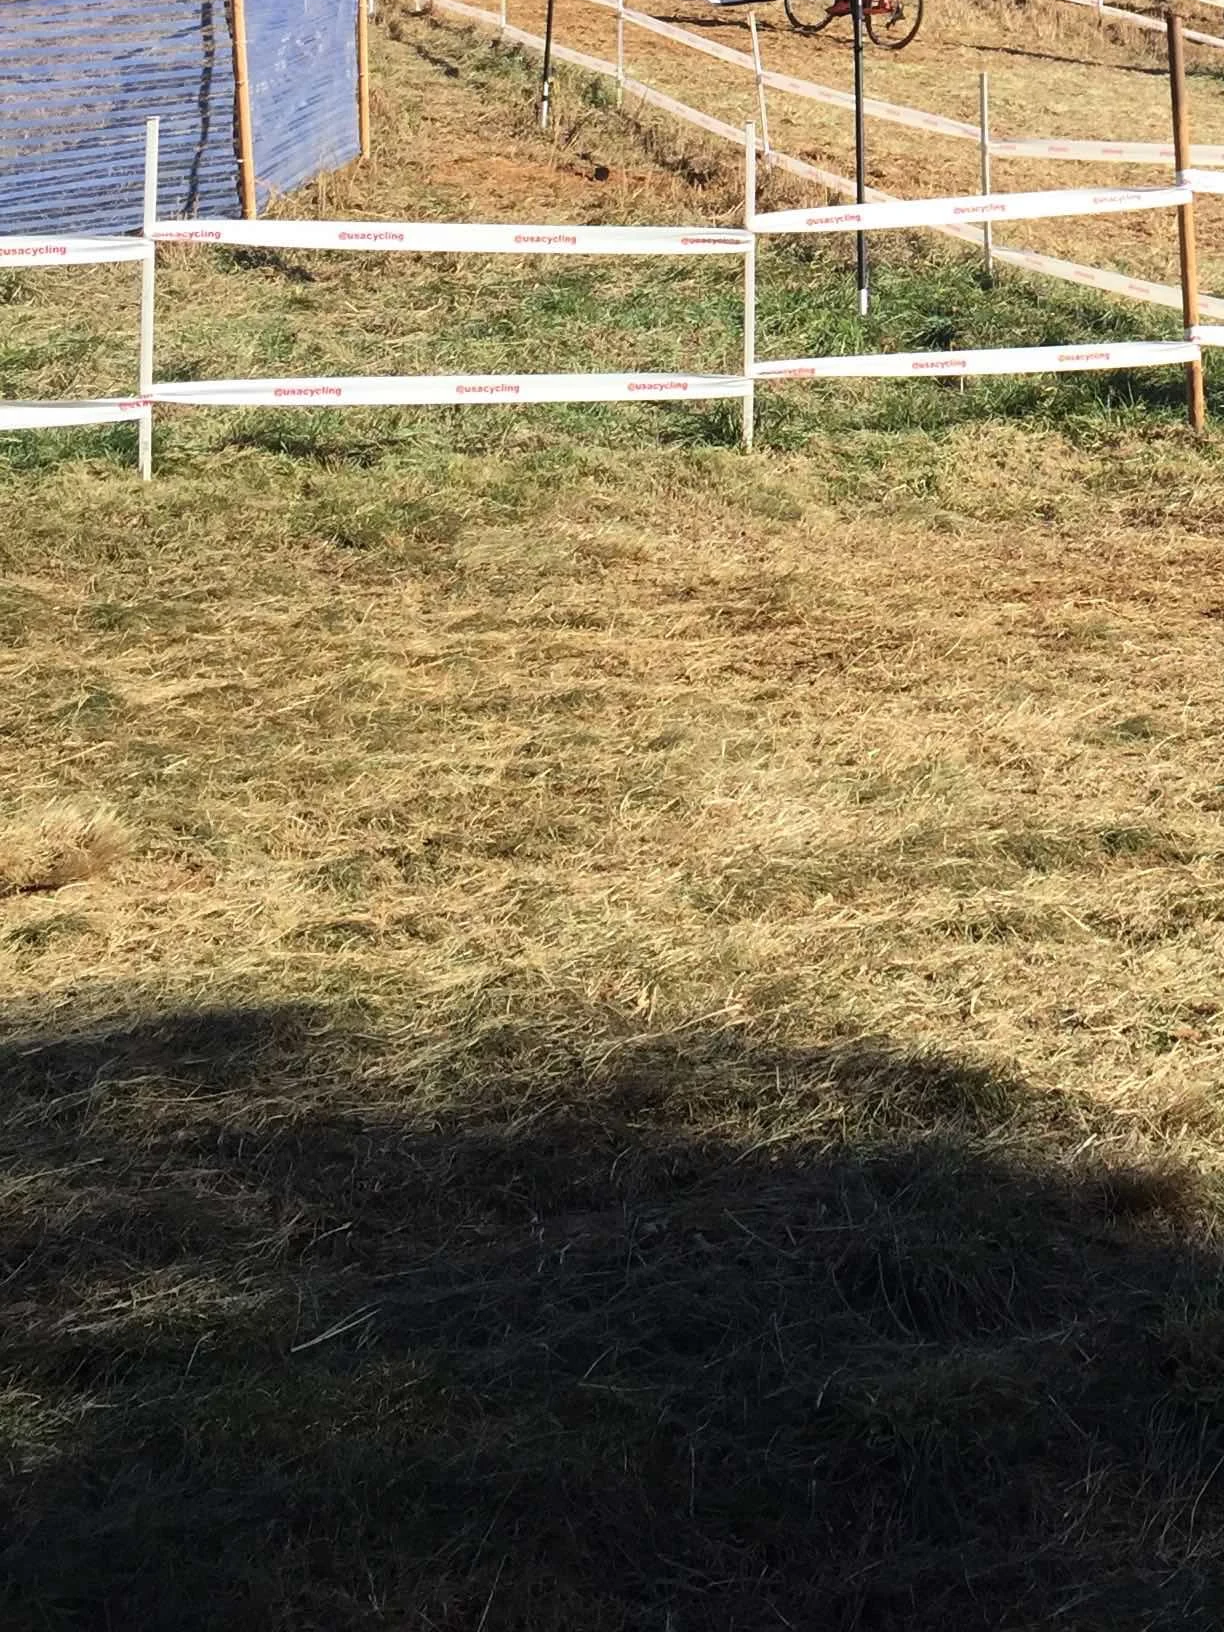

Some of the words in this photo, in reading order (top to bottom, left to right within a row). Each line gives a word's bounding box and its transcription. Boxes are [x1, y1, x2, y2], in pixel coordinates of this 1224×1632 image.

[338, 231, 405, 242] @usacycling
[514, 234, 577, 245] @usacycling
[806, 214, 862, 227] @usacycling
[274, 386, 342, 398] @usacycling
[456, 384, 520, 395] @usacycling
[627, 380, 689, 392] @usacycling
